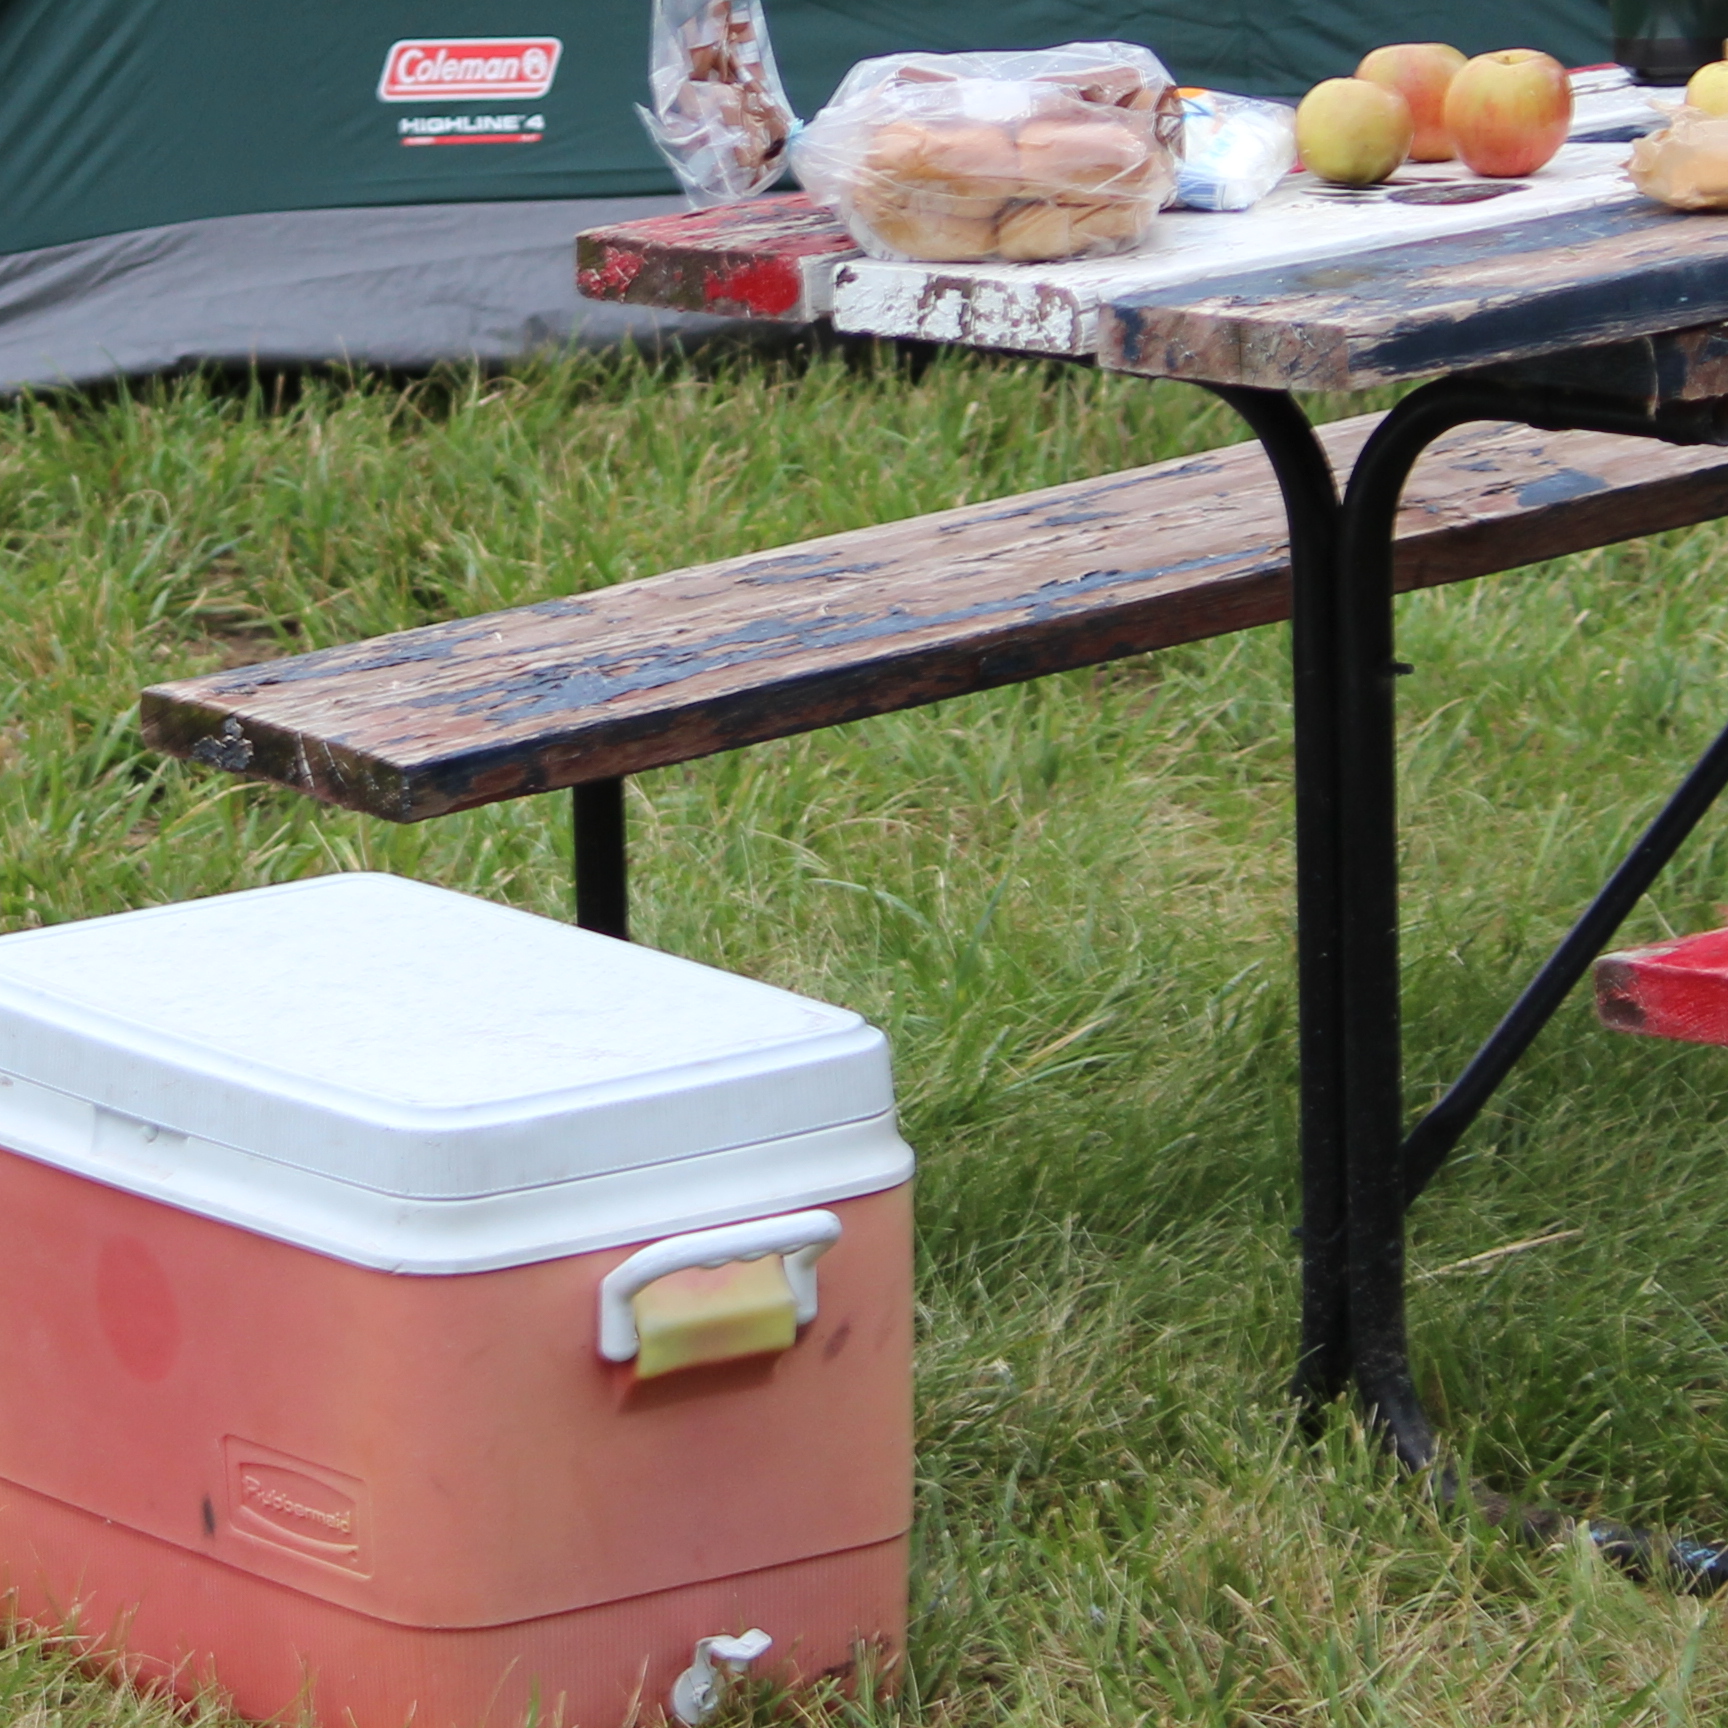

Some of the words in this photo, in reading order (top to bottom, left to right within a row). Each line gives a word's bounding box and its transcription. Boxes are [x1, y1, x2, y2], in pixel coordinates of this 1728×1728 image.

[397, 49, 521, 84] Coleman
[522, 114, 546, 131] 4
[242, 1475, 351, 1535] Rubbermaid
